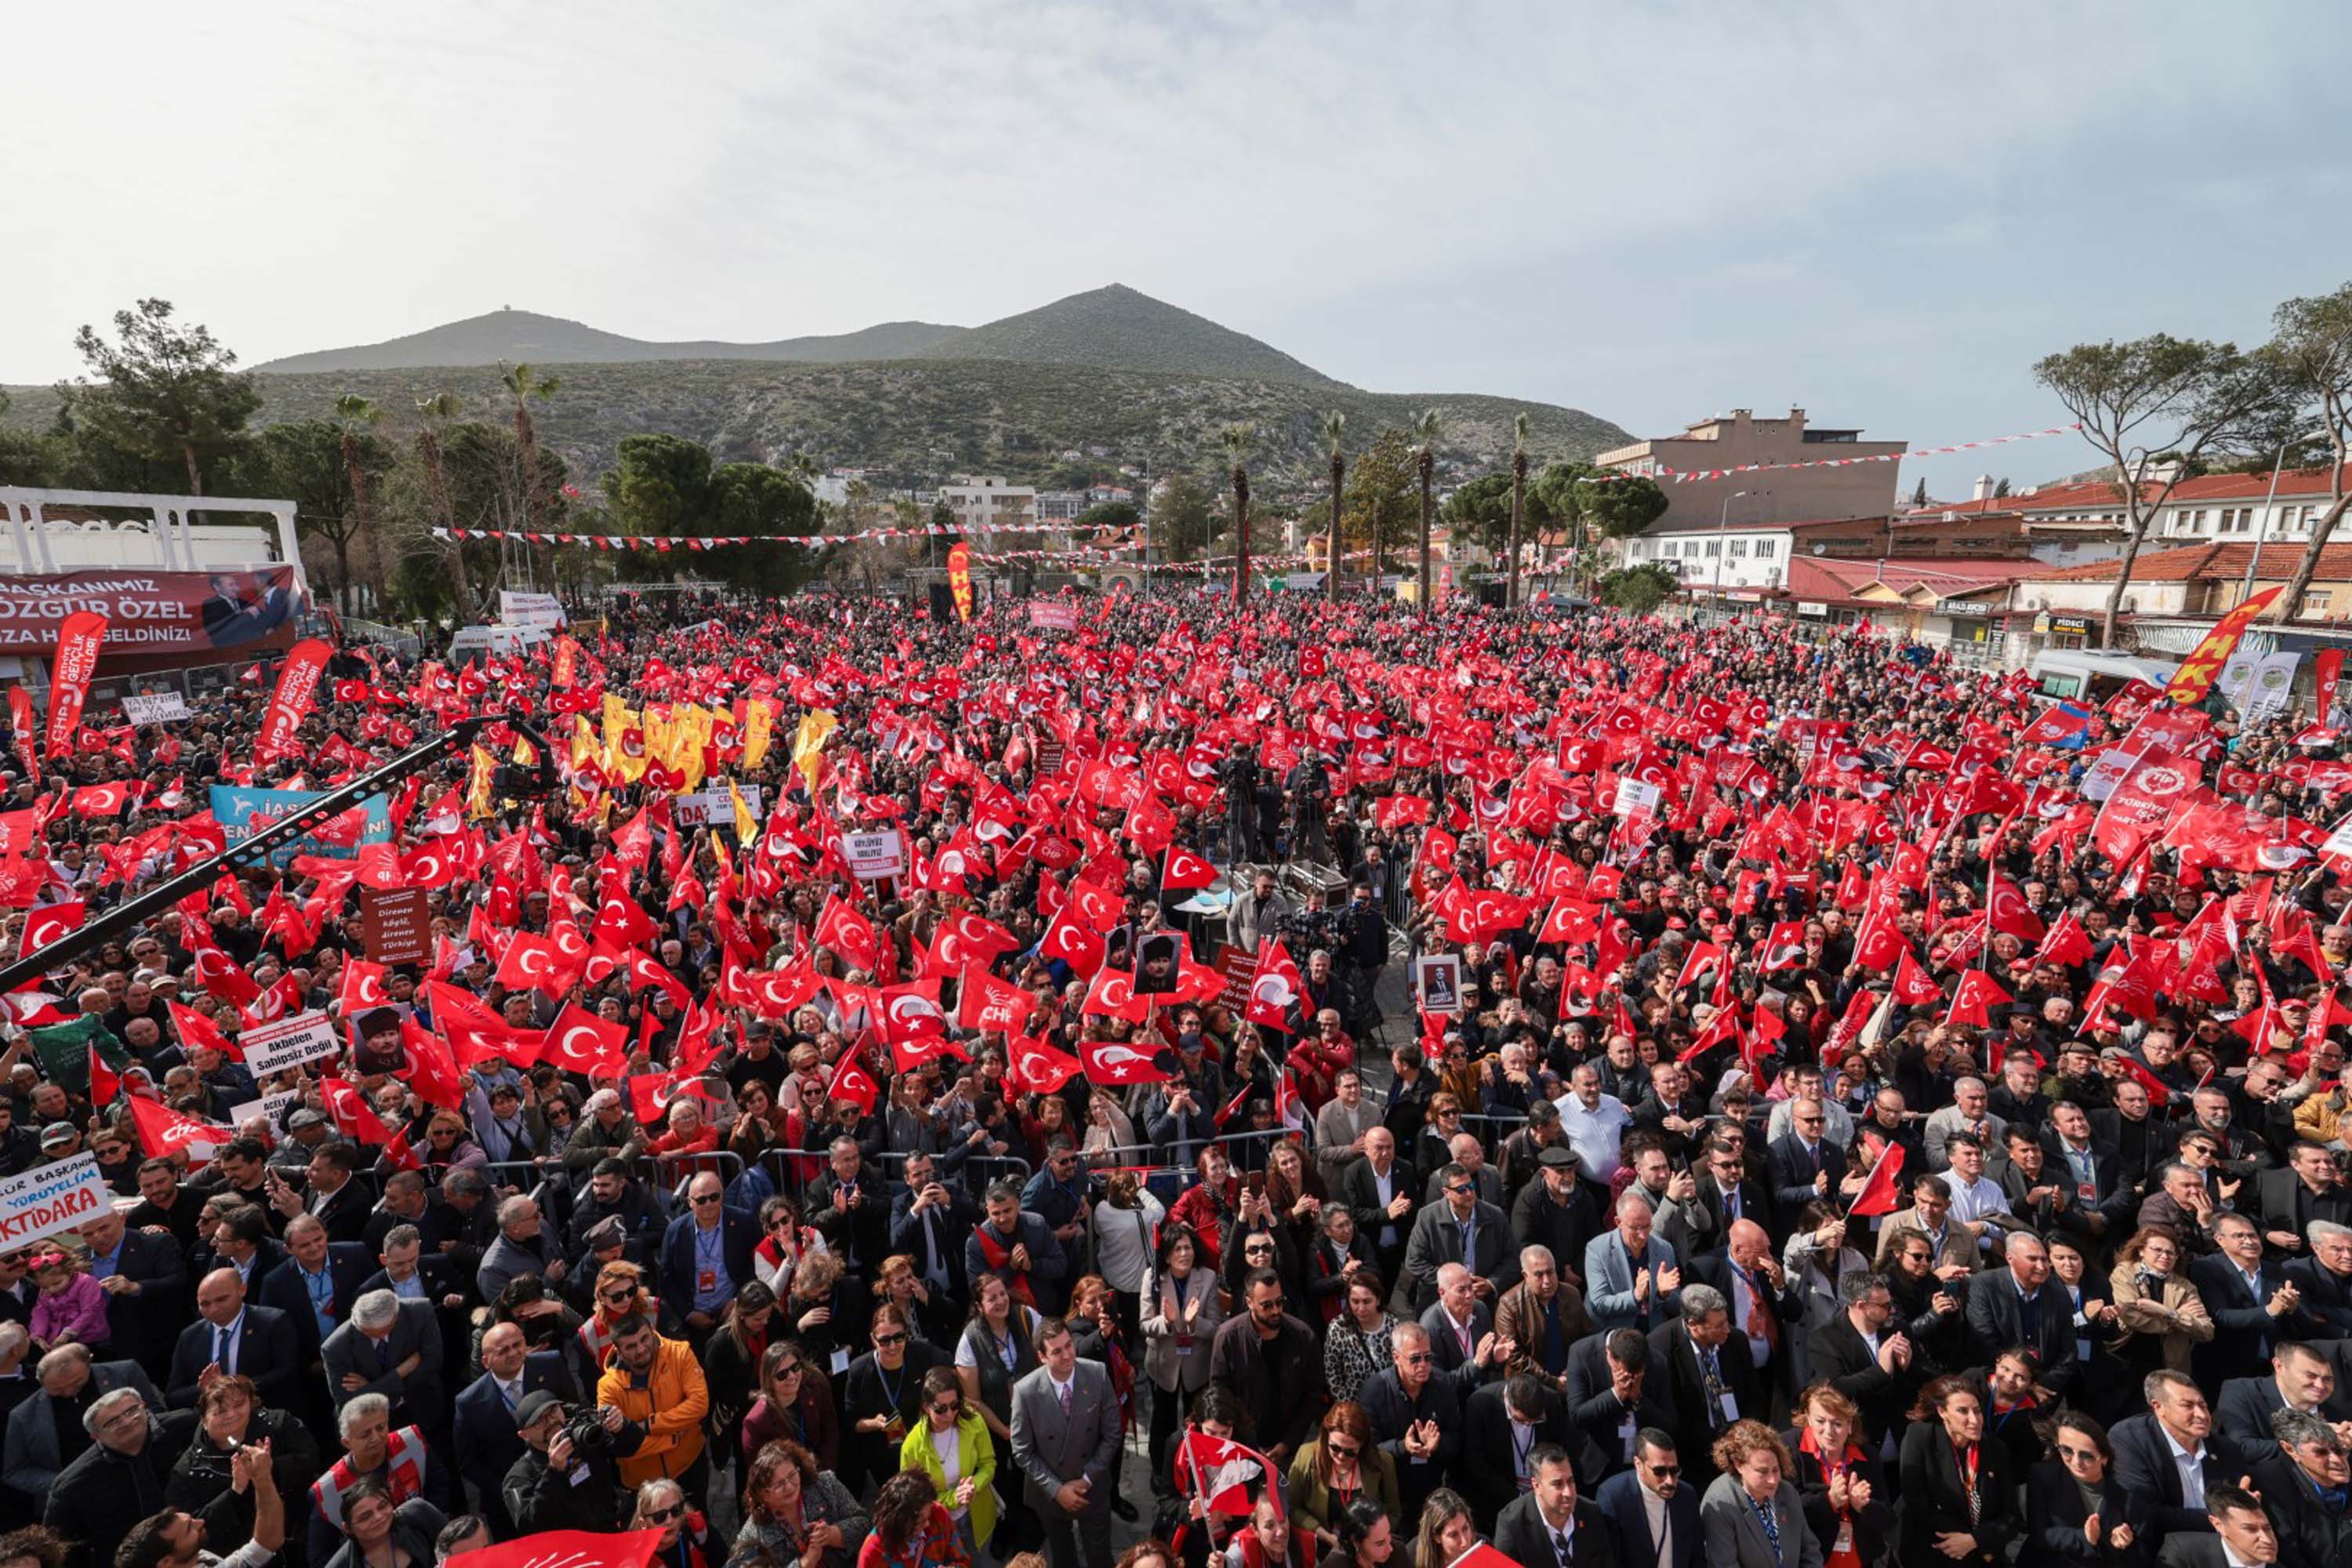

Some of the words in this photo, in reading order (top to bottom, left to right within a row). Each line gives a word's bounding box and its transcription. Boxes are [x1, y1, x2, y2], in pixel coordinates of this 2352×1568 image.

[118, 596, 193, 619] ÖZEL
[2057, 618, 2085, 628] PİDECİ
[68, 633, 85, 682] GENÇLİK
[283, 659, 310, 704] GENÇLİK
[294, 664, 321, 709] KOLLARI
[52, 707, 68, 742] CHP
[2118, 796, 2167, 814] TÜRKİYE
[1041, 846, 1062, 859] CHP
[379, 907, 413, 917] Direnen
[381, 928, 415, 938] direnen
[383, 940, 417, 950] Türkiye
[268, 1032, 313, 1053] Akbelen
[256, 1050, 304, 1071] Sahipsiz
[304, 1039, 332, 1056] Değil
[34, 1157, 96, 1184] BAŞKANIM
[0, 1187, 98, 1243] KTİDARA
